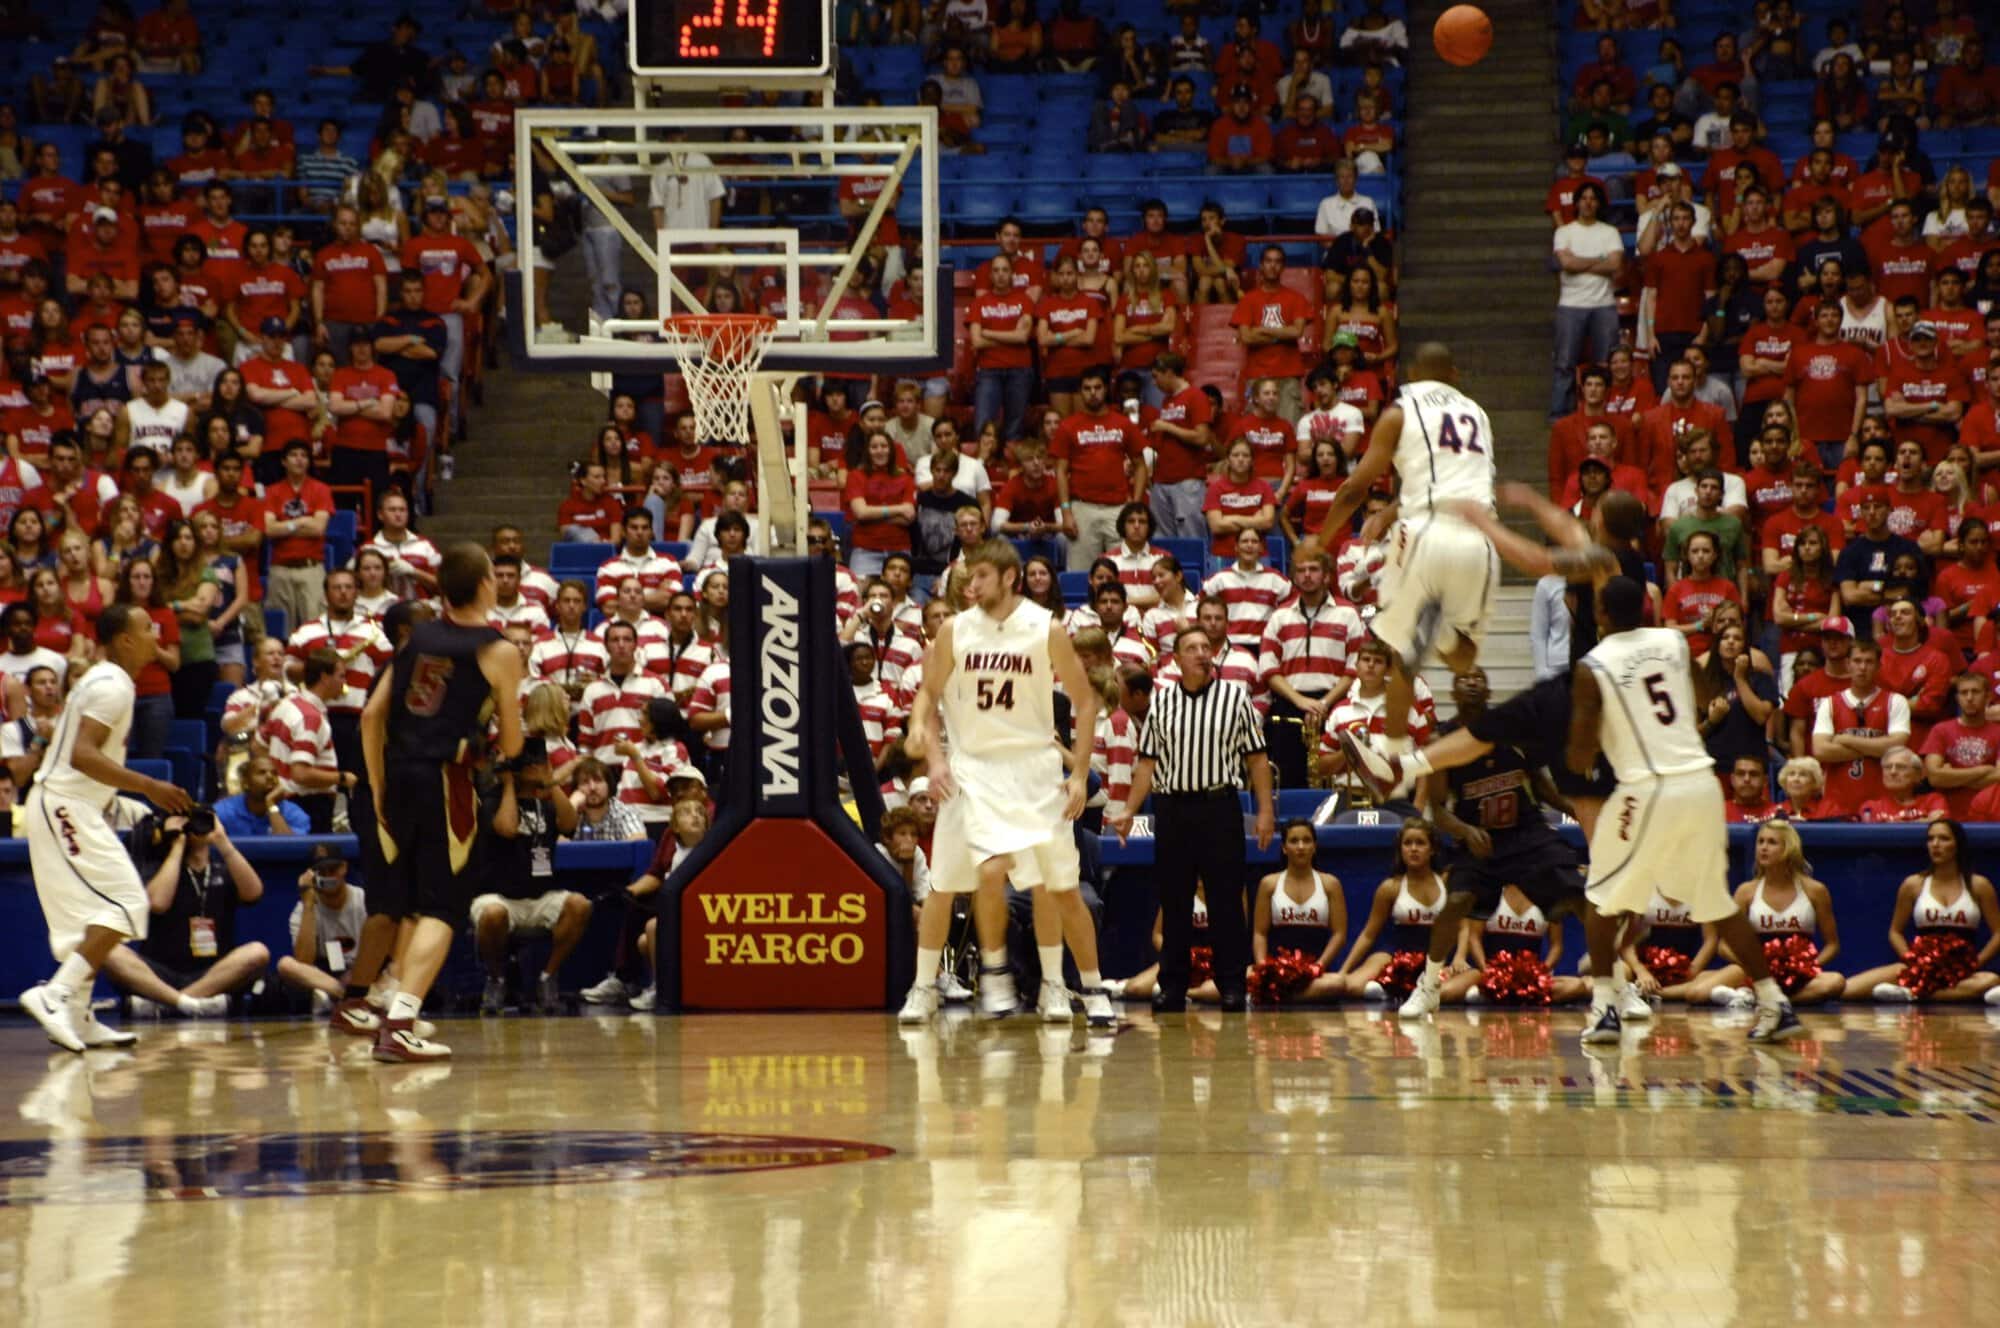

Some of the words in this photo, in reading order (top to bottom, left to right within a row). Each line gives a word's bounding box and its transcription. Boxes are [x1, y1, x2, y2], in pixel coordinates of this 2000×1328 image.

[679, 0, 779, 57] 24
[1438, 411, 1484, 455] 42
[964, 652, 1033, 676] ARIZONA
[761, 573, 800, 796] ARIZONA
[976, 678, 1015, 711] 54
[1643, 672, 1678, 726] 5
[700, 892, 867, 925] WELLS
[706, 932, 865, 965] FARGO
